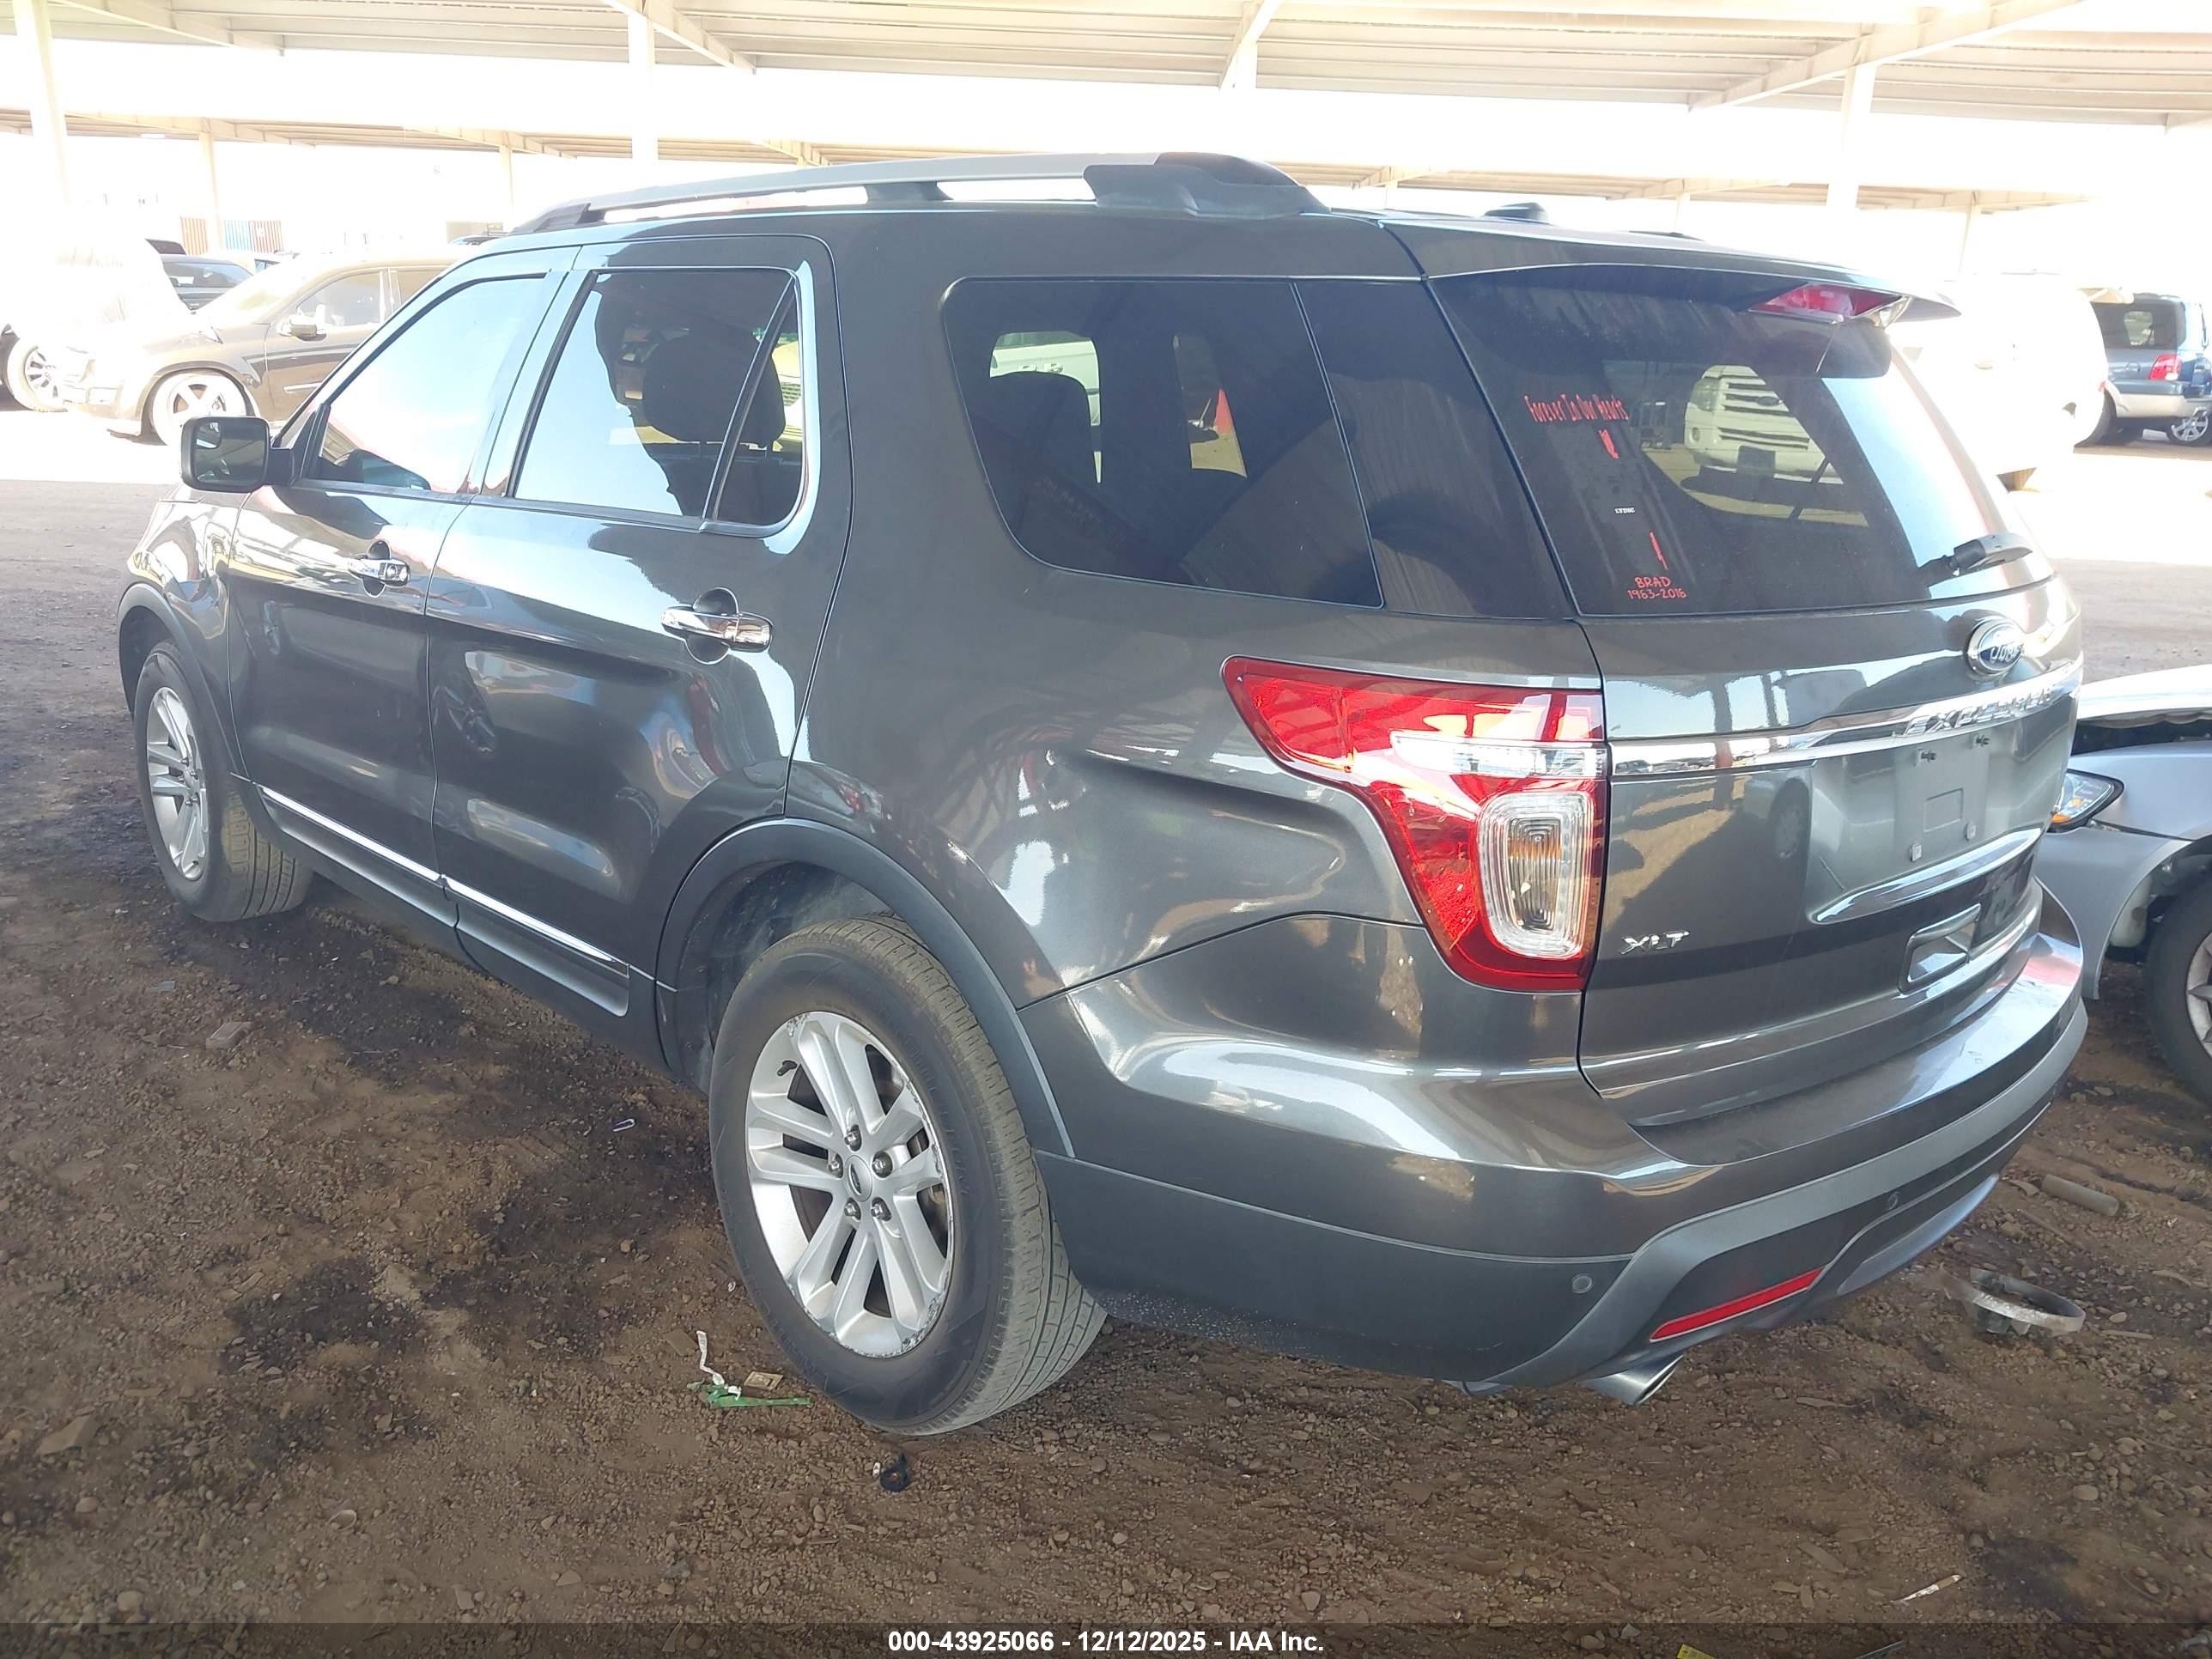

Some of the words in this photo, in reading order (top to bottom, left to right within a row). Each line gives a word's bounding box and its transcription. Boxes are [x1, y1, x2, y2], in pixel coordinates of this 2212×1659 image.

[1523, 395, 1566, 422] Forever
[1560, 393, 1582, 422] In
[1575, 394, 1598, 420] Our
[1593, 394, 1629, 421] Hearts
[1634, 576, 1671, 588] BRAD
[1620, 930, 1690, 955] XLT
